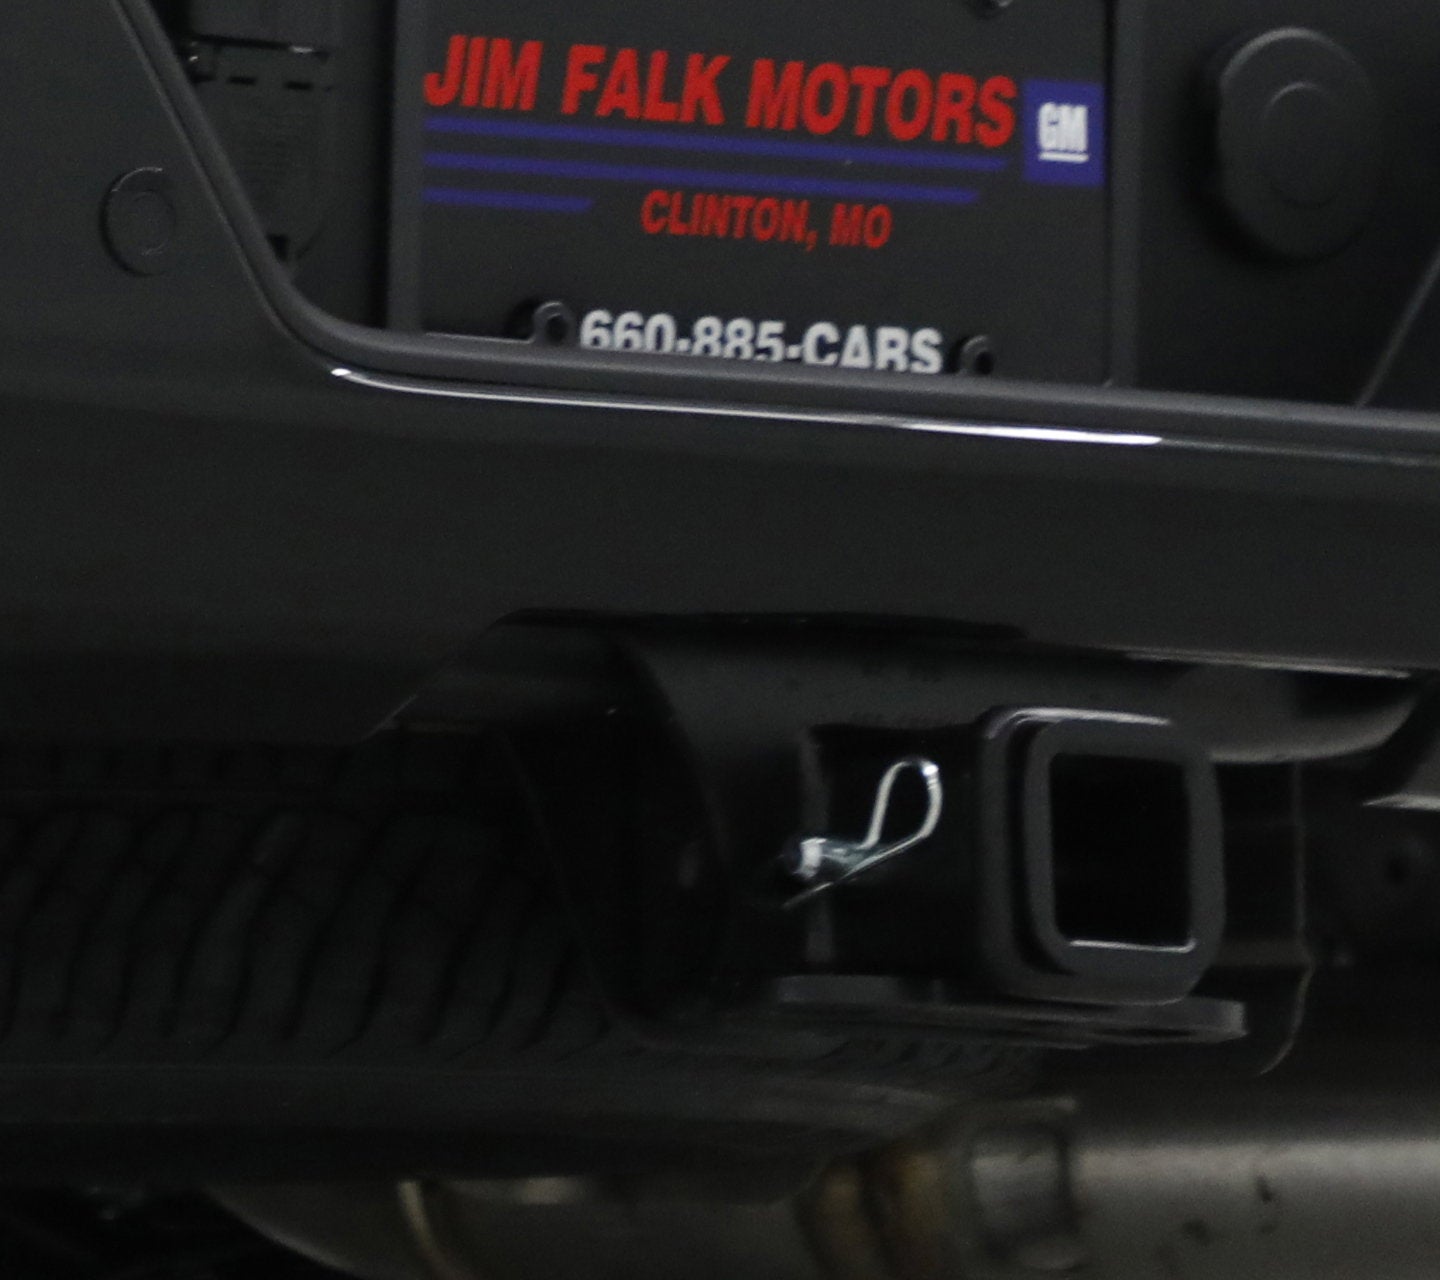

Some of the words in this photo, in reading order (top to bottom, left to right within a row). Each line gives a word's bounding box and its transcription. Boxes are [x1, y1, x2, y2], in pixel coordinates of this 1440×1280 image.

[423, 34, 543, 111] JIM
[561, 44, 730, 124] FALK
[746, 58, 1017, 148] MOTORS
[1037, 101, 1089, 154] GM
[641, 189, 817, 251] CLINTON,
[829, 203, 893, 249] MO
[579, 308, 945, 375] 660-885-CARS
